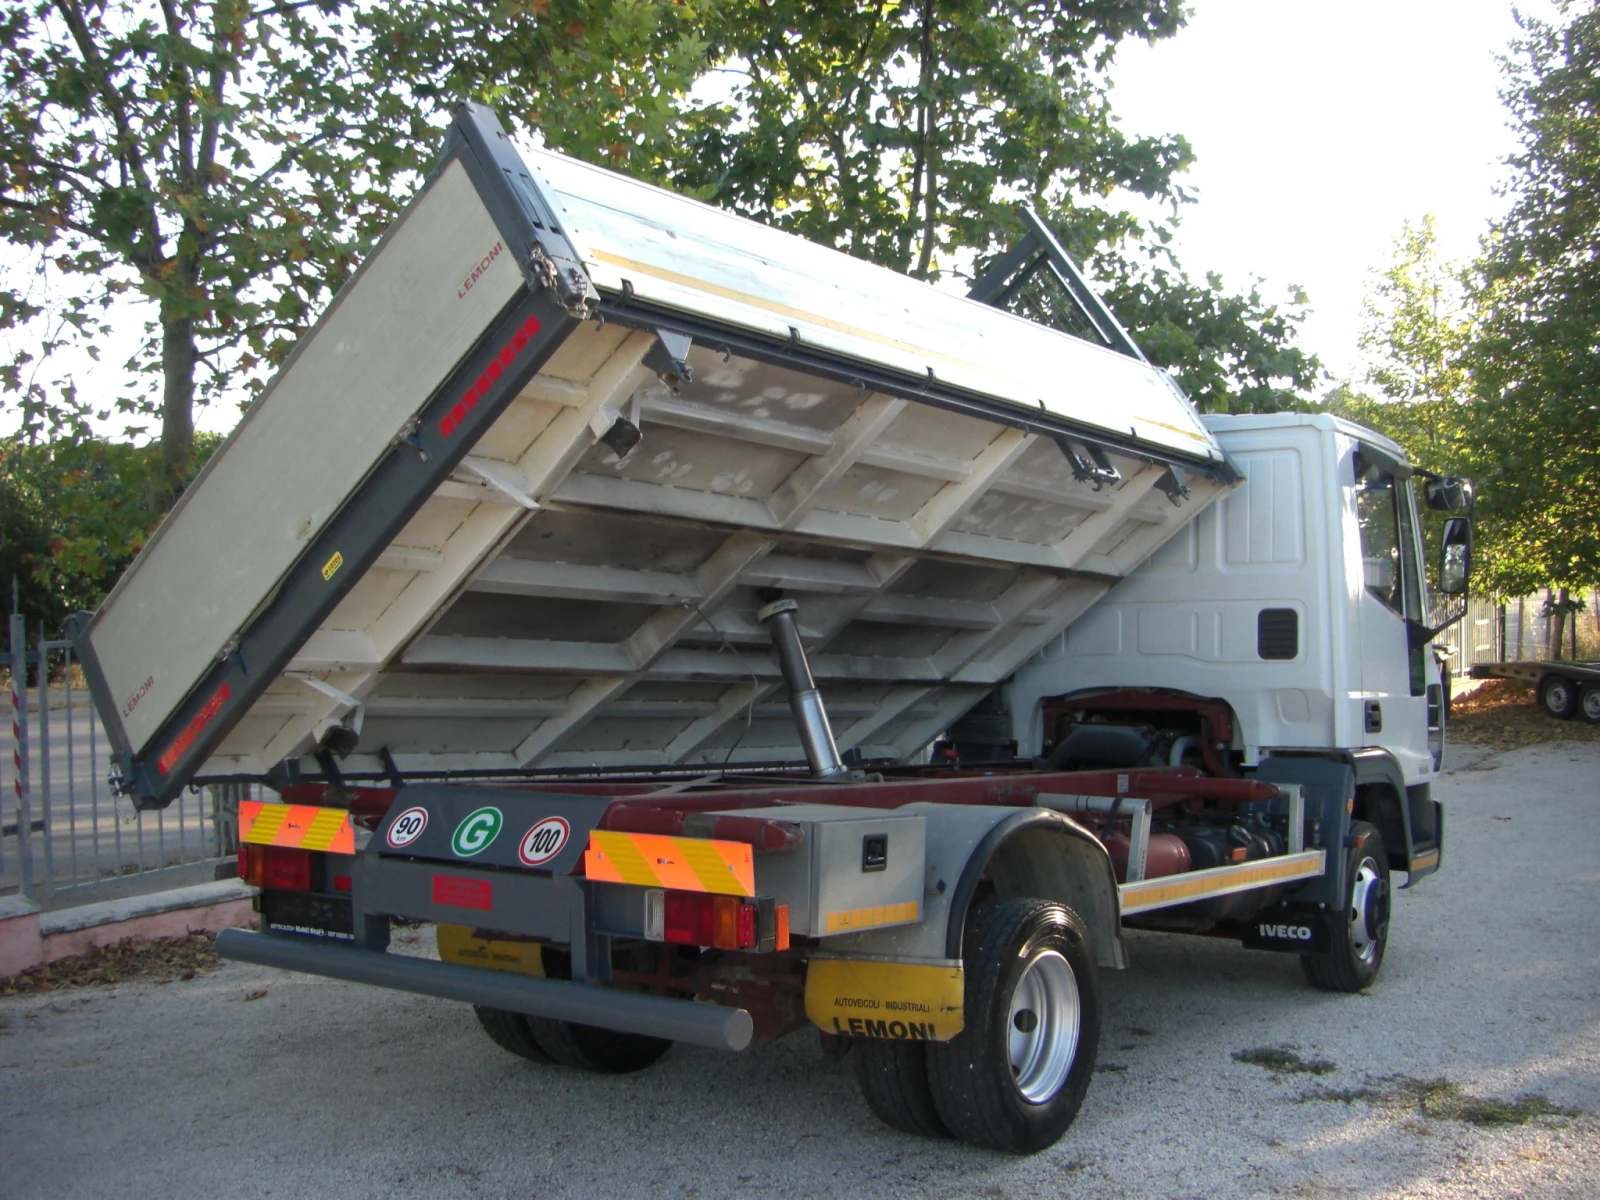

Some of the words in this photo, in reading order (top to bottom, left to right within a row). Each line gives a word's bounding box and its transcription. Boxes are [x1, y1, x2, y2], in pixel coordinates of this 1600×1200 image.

[457, 242, 503, 299] LEMONI
[122, 675, 154, 718] LEMONI
[396, 816, 422, 835] 90
[459, 813, 495, 850] G
[529, 828, 561, 854] 100
[1259, 924, 1312, 940] IVECO
[834, 998, 880, 1009] AUTOVEICOLI
[885, 1001, 930, 1013] INDUSTRIALI
[832, 1017, 936, 1040] LEMONI
